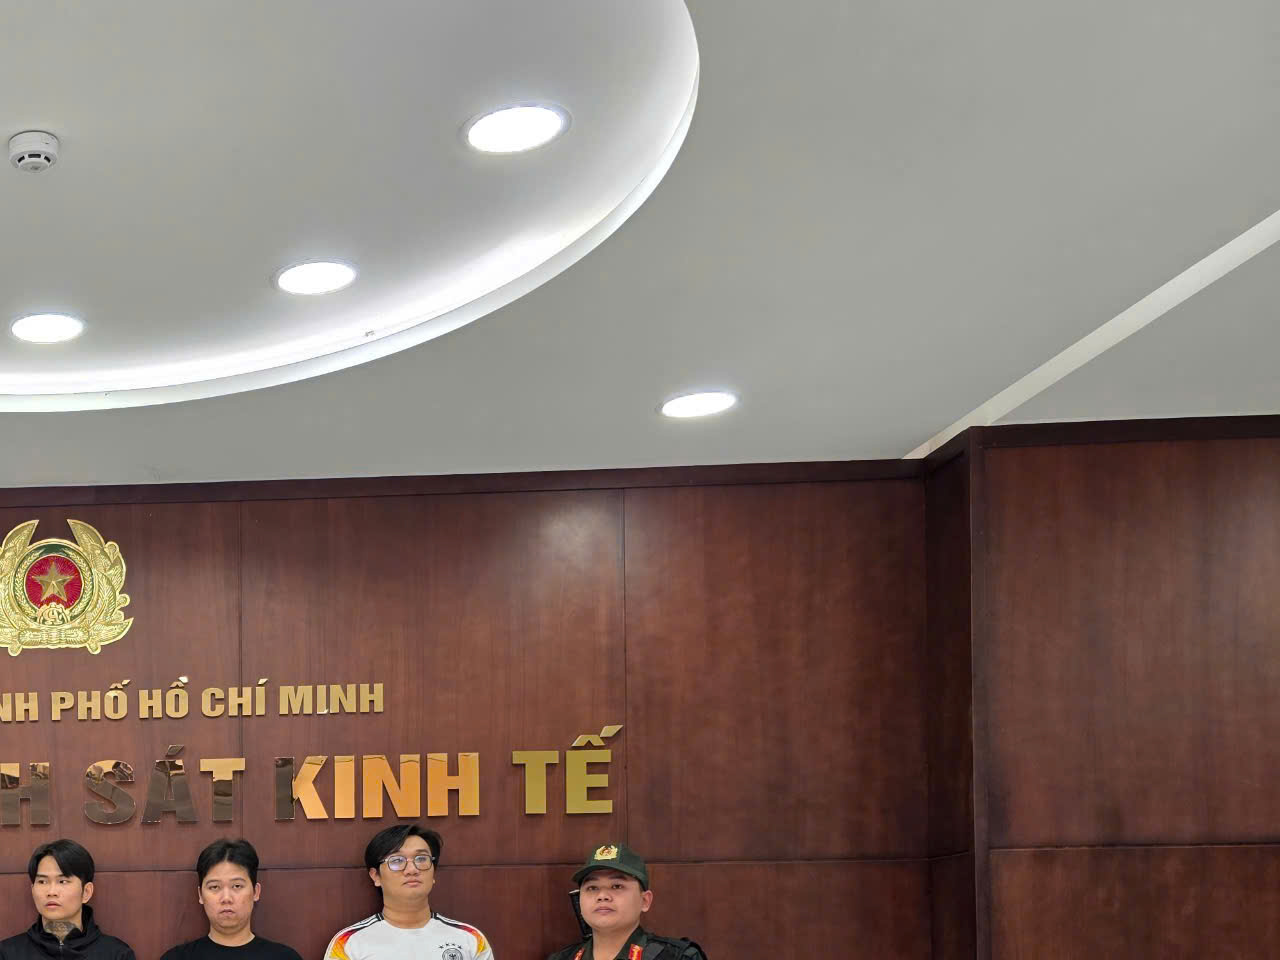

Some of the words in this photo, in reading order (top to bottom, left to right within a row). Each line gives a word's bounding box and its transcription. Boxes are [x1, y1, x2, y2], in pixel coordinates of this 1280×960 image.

[50, 678, 132, 721] PHỐ
[138, 675, 190, 719] HỒ
[200, 677, 270, 717] CHÍ
[279, 682, 385, 715] MINH
[83, 744, 246, 825] SÁT
[274, 752, 480, 821] KINH
[511, 724, 624, 815] TẾ
